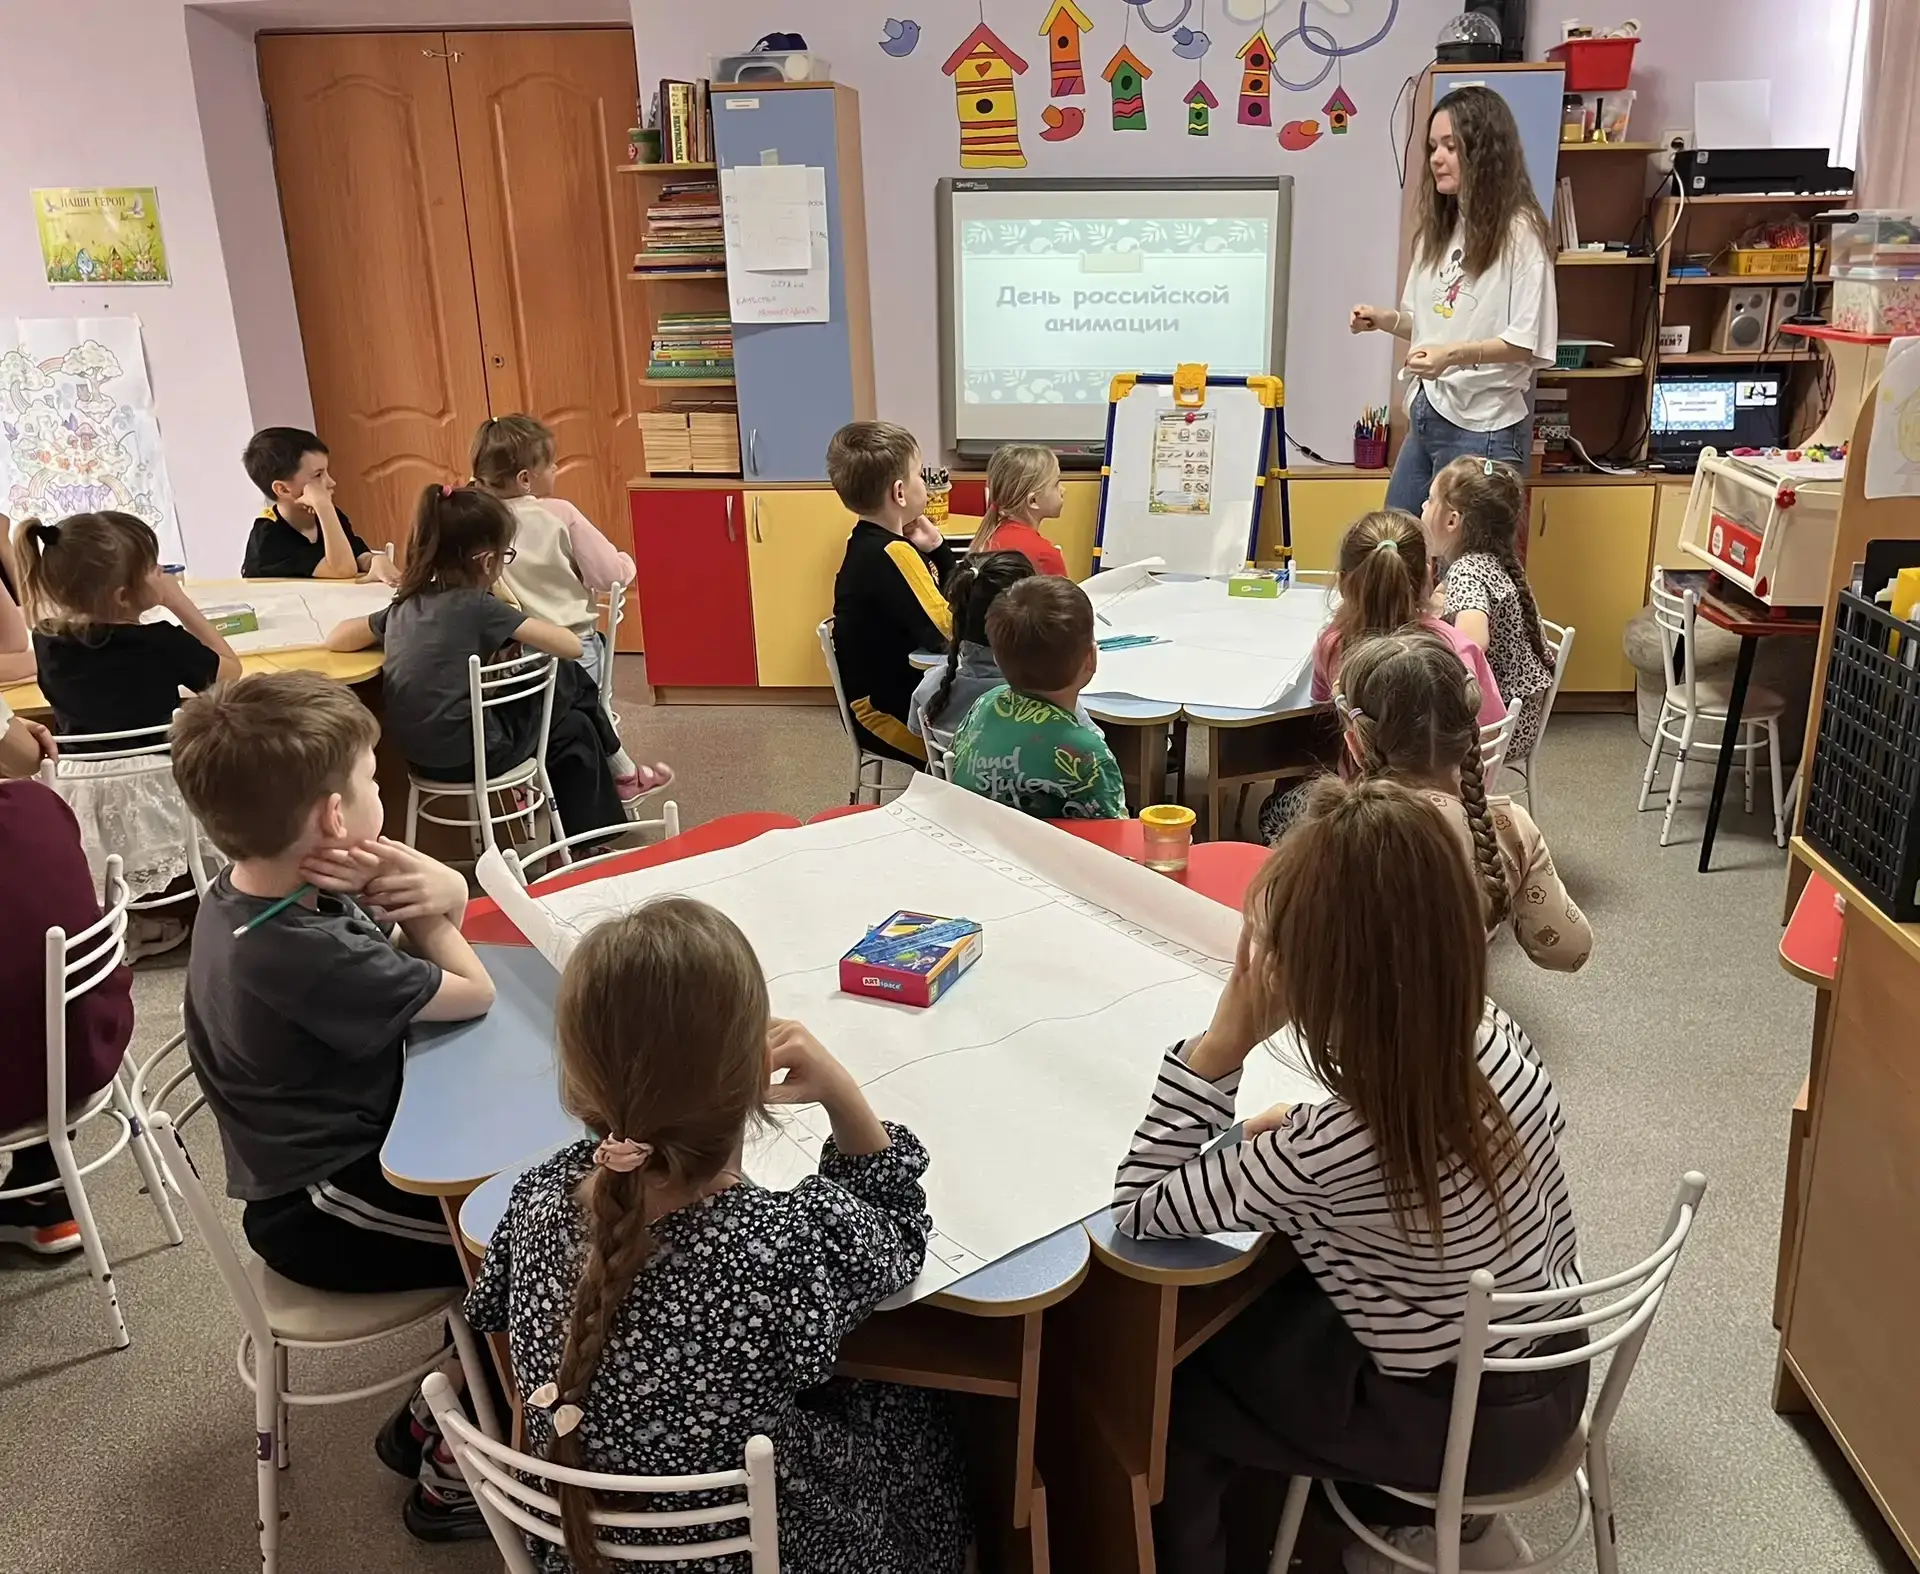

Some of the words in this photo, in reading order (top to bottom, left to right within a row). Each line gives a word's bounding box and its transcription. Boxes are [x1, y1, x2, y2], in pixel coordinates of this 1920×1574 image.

[61, 196, 90, 208] НАШИ
[95, 196, 126, 207] ГЕРОИ
[996, 286, 1061, 307] День
[1073, 284, 1230, 309] российской
[1045, 317, 1180, 333] анимации
[967, 746, 1022, 776] Hand
